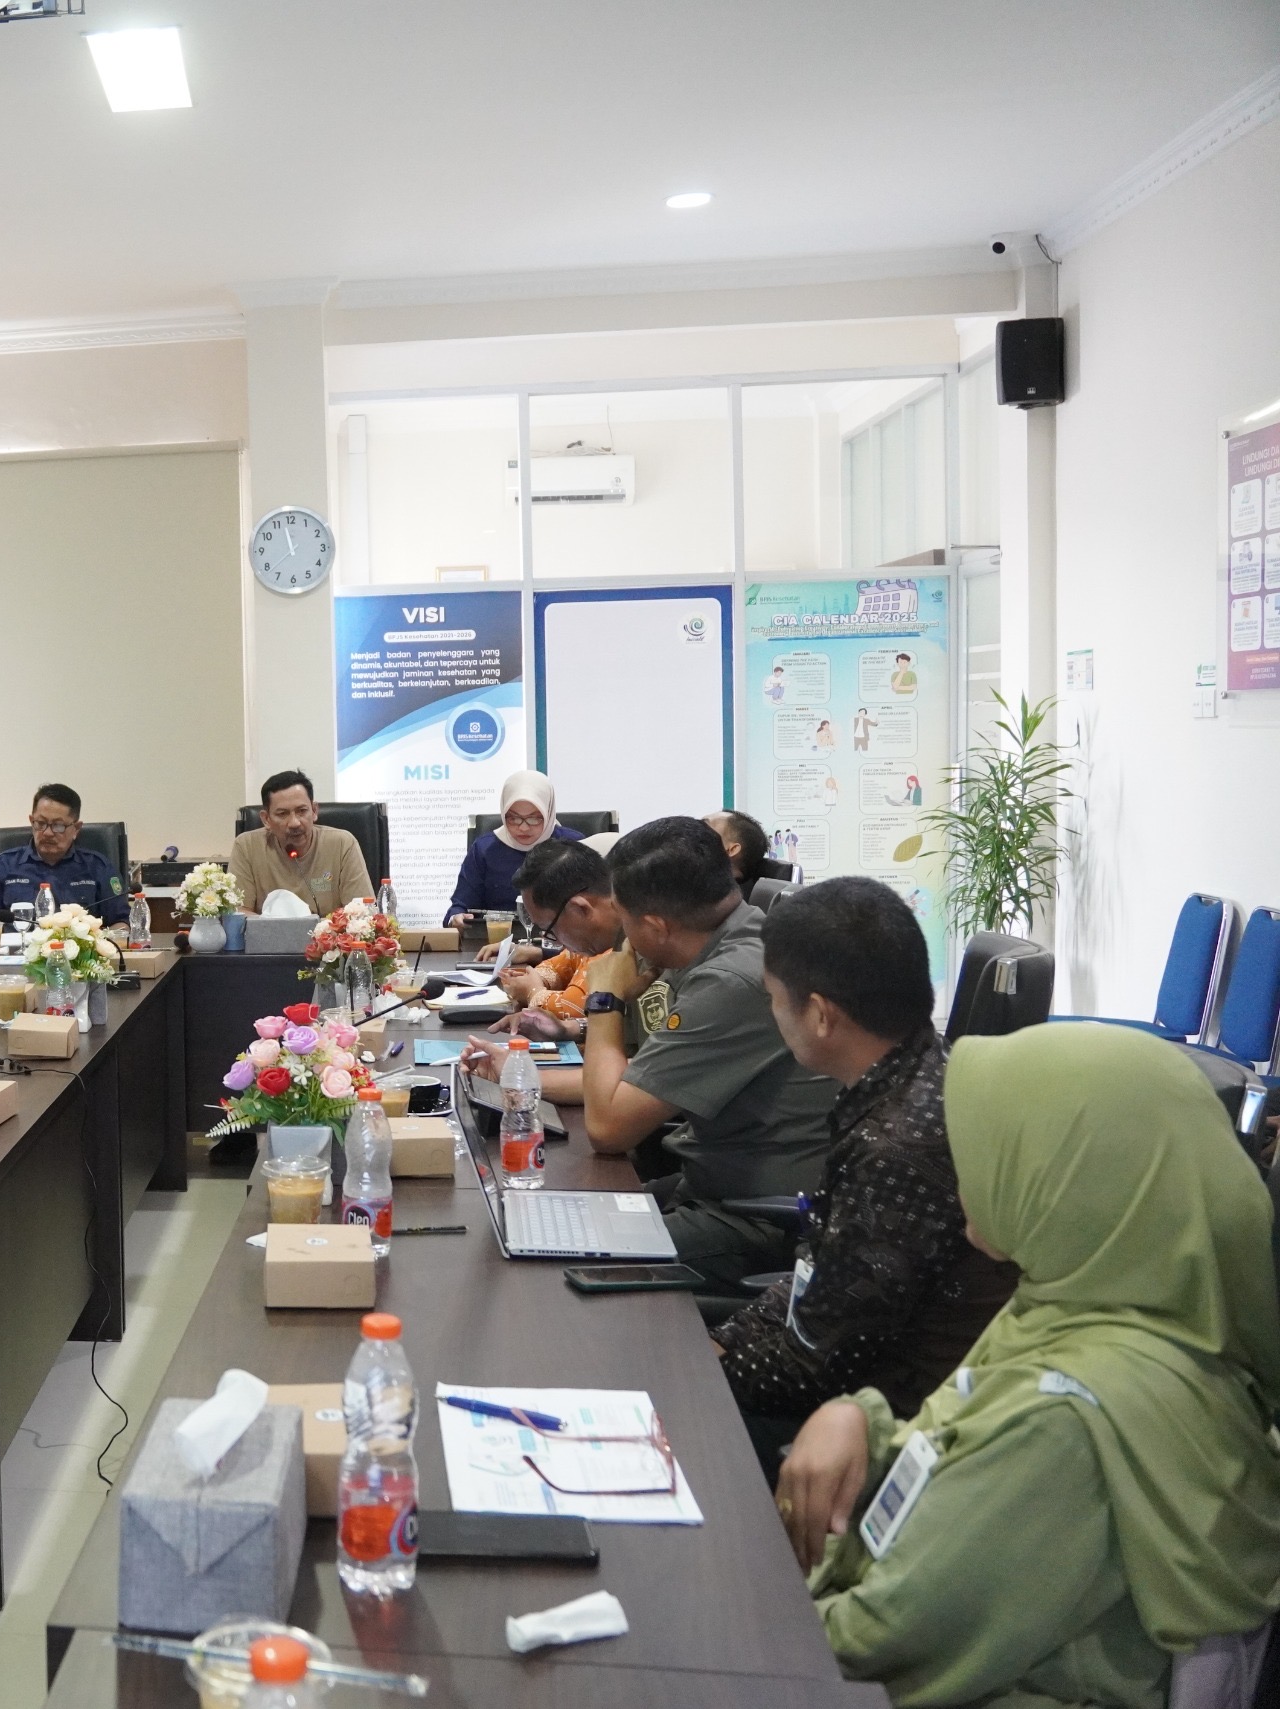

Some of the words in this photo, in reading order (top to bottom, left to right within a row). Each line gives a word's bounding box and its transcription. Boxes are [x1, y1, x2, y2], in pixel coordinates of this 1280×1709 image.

[272, 520, 281, 529] 11
[286, 515, 296, 525] 12
[304, 518, 308, 527] 1
[262, 531, 272, 541] 10
[314, 529, 320, 538] 2
[258, 547, 264, 556] 9
[320, 543, 326, 552] 3
[264, 562, 270, 571] 8
[315, 559, 322, 567] 4
[275, 572, 281, 581] 7
[305, 570, 311, 579] 5
[290, 575, 297, 584] 6
[402, 606, 446, 624] VISI
[773, 615, 798, 626] CIA
[802, 613, 880, 625] CALENDAR
[351, 651, 381, 661] Menjadi
[386, 651, 411, 659] badan
[418, 650, 474, 659] penyelenggara
[481, 649, 500, 657] yang
[351, 661, 382, 670] dinamis,
[383, 660, 423, 669] akuntabel,
[424, 659, 438, 667] dan
[439, 658, 477, 668] tepercaya
[351, 671, 399, 680] mewujudkan
[402, 670, 433, 679] jaminan
[481, 668, 500, 676] yang
[351, 681, 394, 689] berkualitas,
[398, 679, 451, 688] berkelanjutan,
[455, 677, 500, 686] berkeadilan,
[367, 690, 395, 698] inklusif.
[404, 764, 450, 780] MISI
